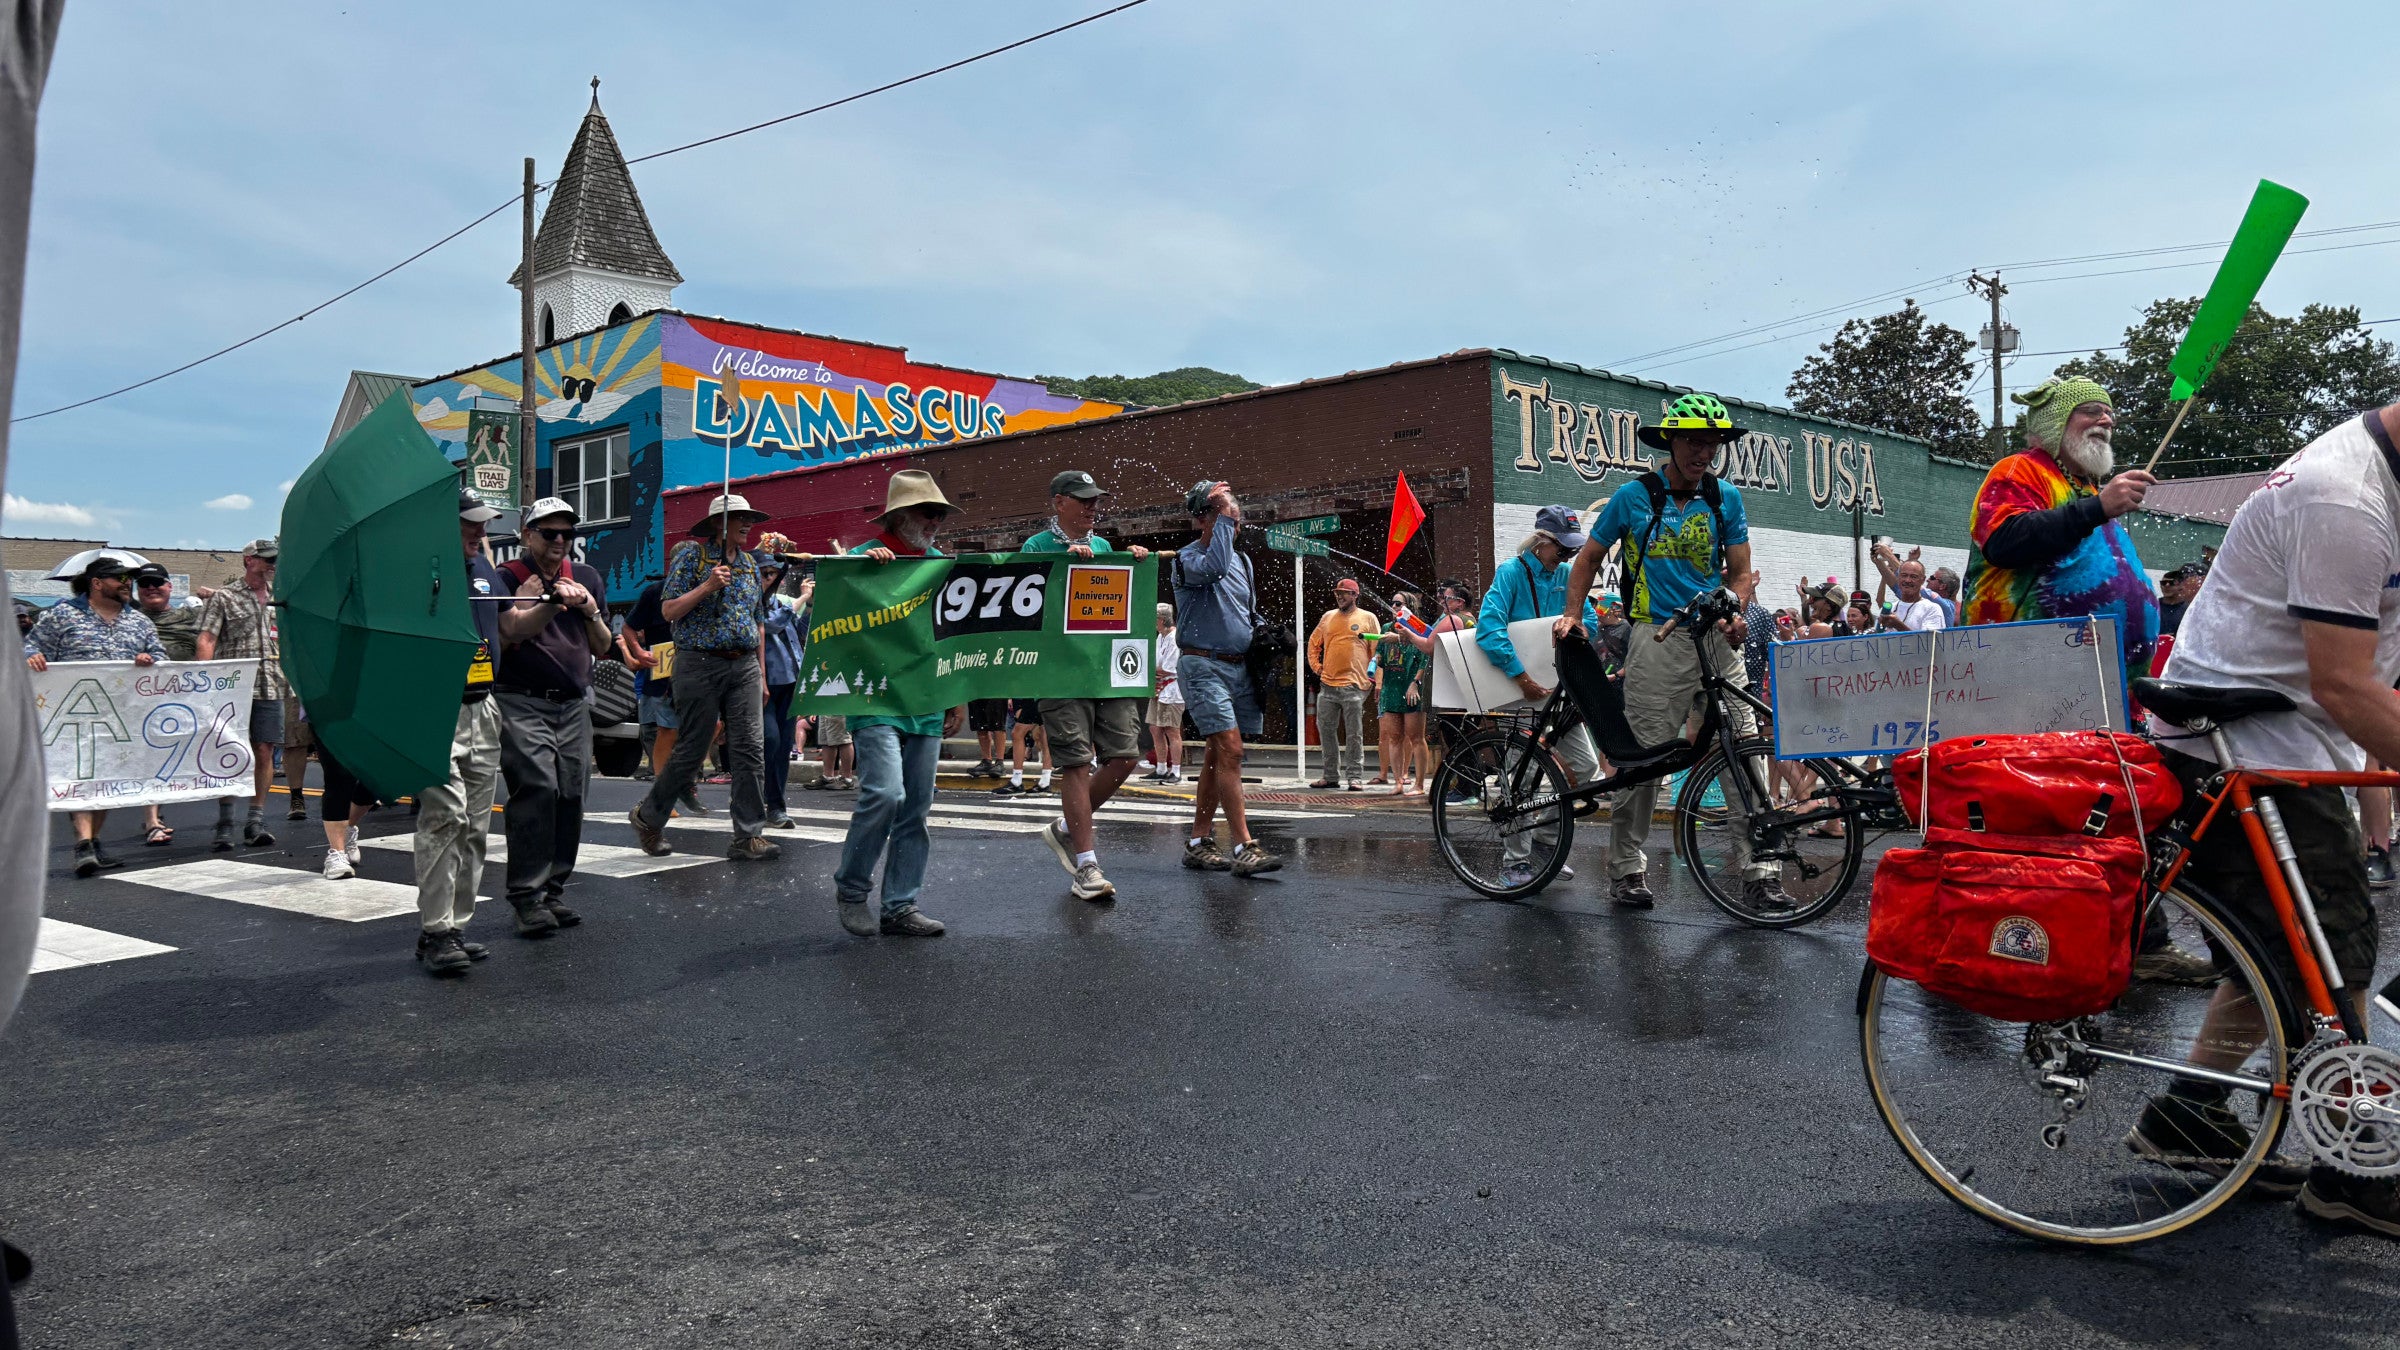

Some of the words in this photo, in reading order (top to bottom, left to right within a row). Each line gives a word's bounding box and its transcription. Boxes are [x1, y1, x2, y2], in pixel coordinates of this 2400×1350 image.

[712, 346, 808, 381] Welcome
[815, 361, 833, 384] to
[692, 376, 1006, 452] DAMASCUS
[1499, 367, 1654, 485] TRAIL
[477, 471, 507, 481] TRAIL
[480, 479, 505, 489] DAYS
[1309, 519, 1327, 533] AVE
[1090, 576, 1109, 585] 50th
[1074, 590, 1123, 603] Anniversary
[811, 614, 863, 644] THRU
[867, 588, 934, 629] HIKERS!
[1081, 606, 1093, 616] GA
[1101, 606, 1115, 616] ME
[936, 657, 952, 678] Ron,
[954, 649, 989, 671] Howie,
[992, 647, 1005, 666] &
[1008, 647, 1039, 666] Tom
[1780, 630, 1992, 669] BIKECENTENNIAL
[135, 670, 212, 697] CLASS
[215, 670, 242, 691] of
[1805, 662, 1975, 699] TRANSAMERICA
[1932, 688, 1999, 705] TRAIL
[142, 702, 250, 782] 96
[1801, 725, 1842, 736] Class
[1871, 720, 1940, 746] 1976
[51, 783, 86, 799] WE
[95, 780, 144, 798] HIKED
[152, 782, 165, 792] in
[167, 779, 188, 792] the
